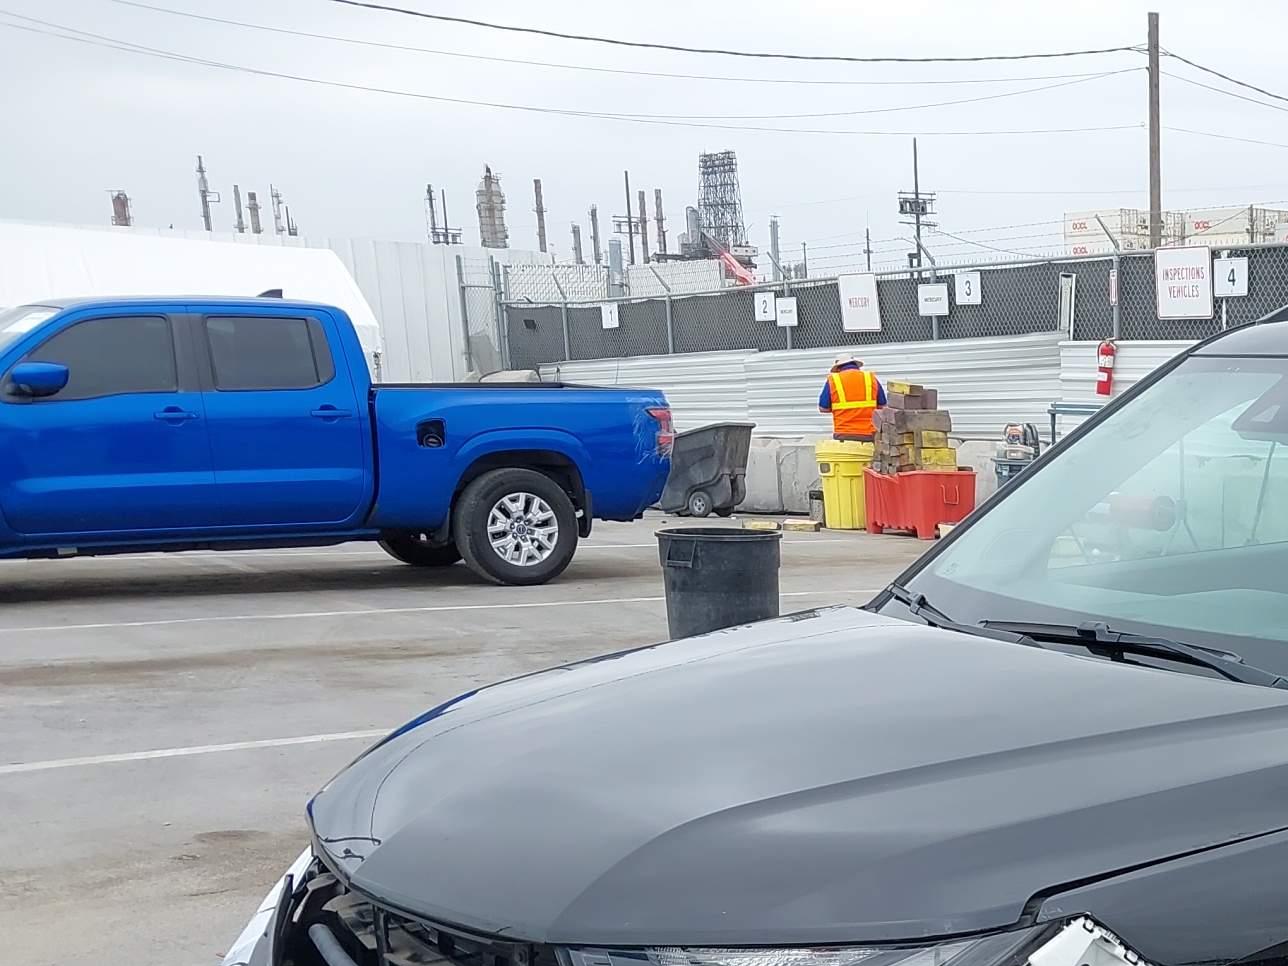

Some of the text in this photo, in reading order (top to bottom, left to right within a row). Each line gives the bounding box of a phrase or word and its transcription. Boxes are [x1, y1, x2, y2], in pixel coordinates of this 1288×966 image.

[1162, 267, 1205, 281] INSPECTIONS
[1227, 267, 1236, 287] 4
[964, 280, 972, 297] 3
[1168, 285, 1200, 298] VEHICLES
[762, 299, 768, 314] 2
[608, 310, 613, 322] 1
